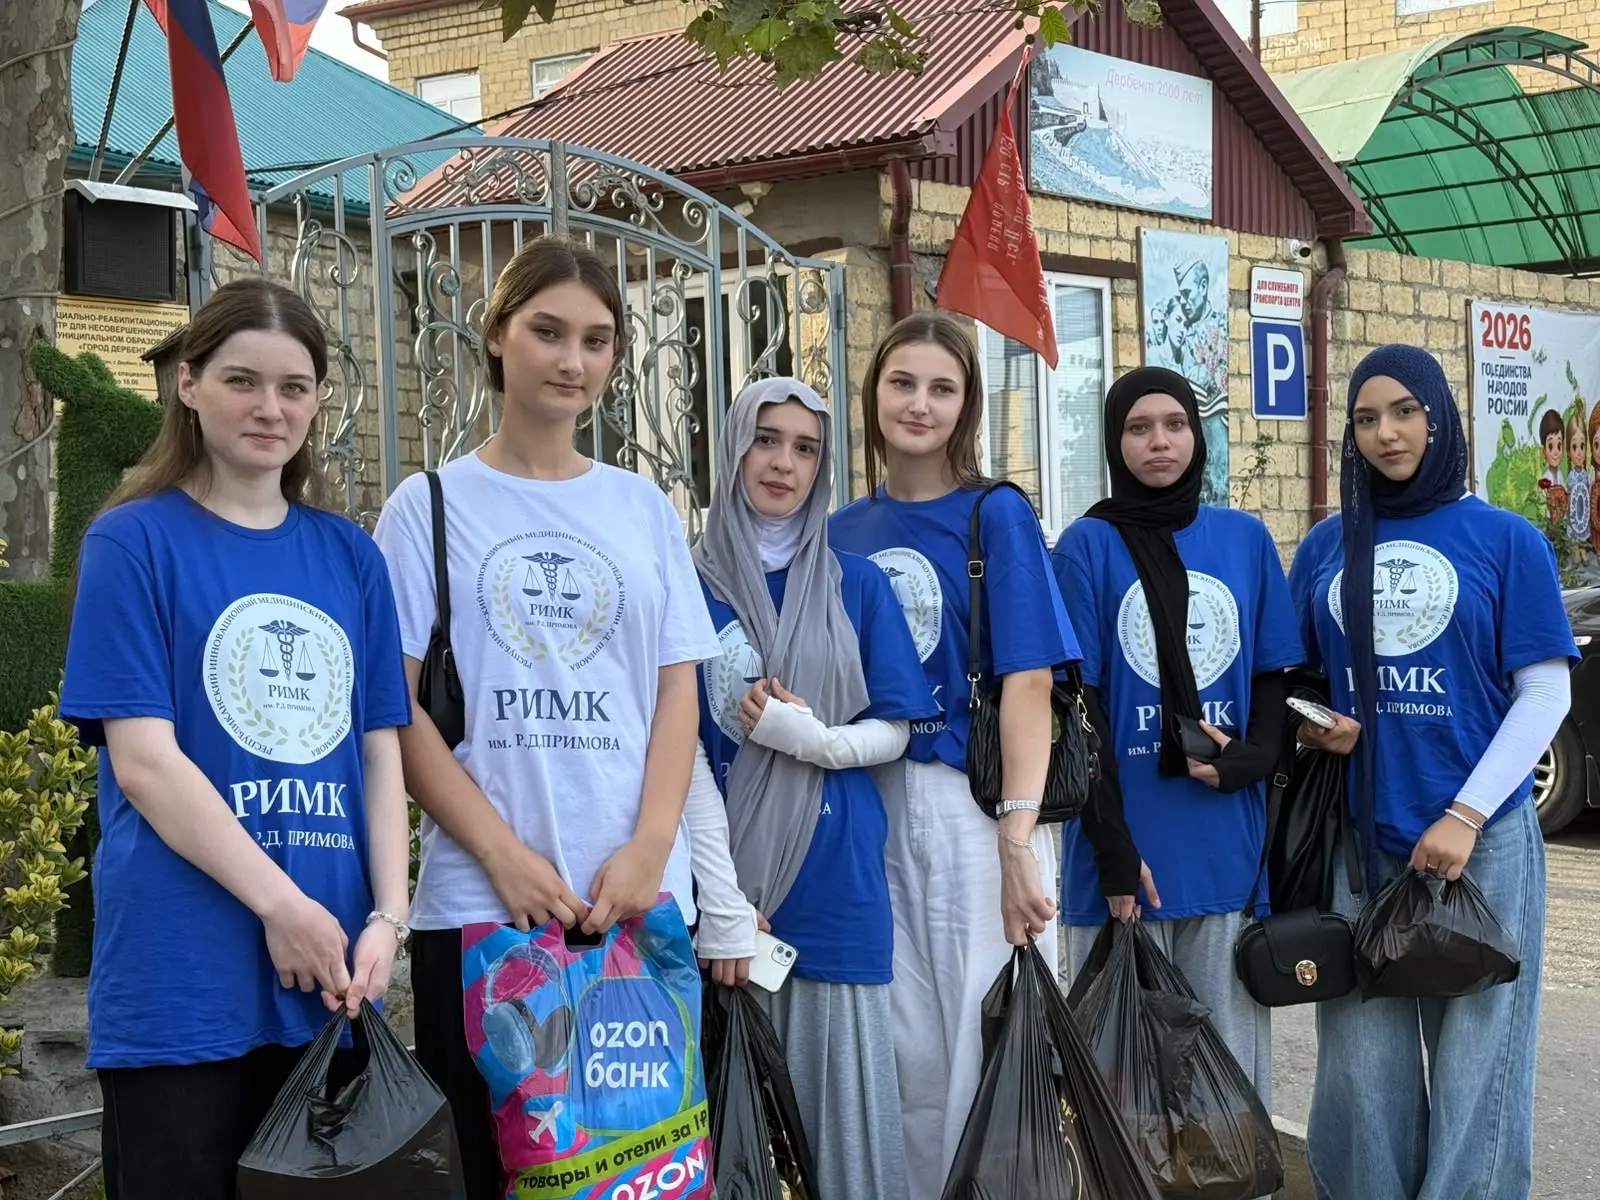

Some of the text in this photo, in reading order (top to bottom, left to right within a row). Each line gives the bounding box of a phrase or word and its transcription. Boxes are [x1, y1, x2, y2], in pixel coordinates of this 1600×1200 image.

[1105, 68, 1204, 105] Дербент 2000 лет
[69, 322, 87, 331] ДЛЯ
[1480, 310, 1532, 351] 2026
[57, 331, 124, 343] УНИЦИПАЛЬНОМ
[111, 345, 147, 354] ДЕРБЕНТ
[1266, 332, 1296, 407] P
[1487, 379, 1528, 398] НАРОДОВ
[1487, 397, 1528, 416] РОССИИ
[529, 603, 575, 619] РИМК
[268, 684, 311, 701] РИМК
[493, 688, 611, 722] РИМК
[1386, 701, 1454, 717] ПРИМОВА
[488, 739, 512, 749] им.
[541, 734, 620, 750] ПРИМОВА
[1128, 746, 1150, 756] им.
[229, 778, 347, 818] РИМК
[288, 830, 355, 850] ПРИМОВА
[590, 1019, 669, 1049] ozon
[585, 1052, 670, 1089] банк
[521, 1166, 590, 1190] товары
[595, 1158, 608, 1173] и
[613, 1134, 667, 1166] отели
[671, 1123, 691, 1143] за
[611, 1148, 705, 1200] OZON
